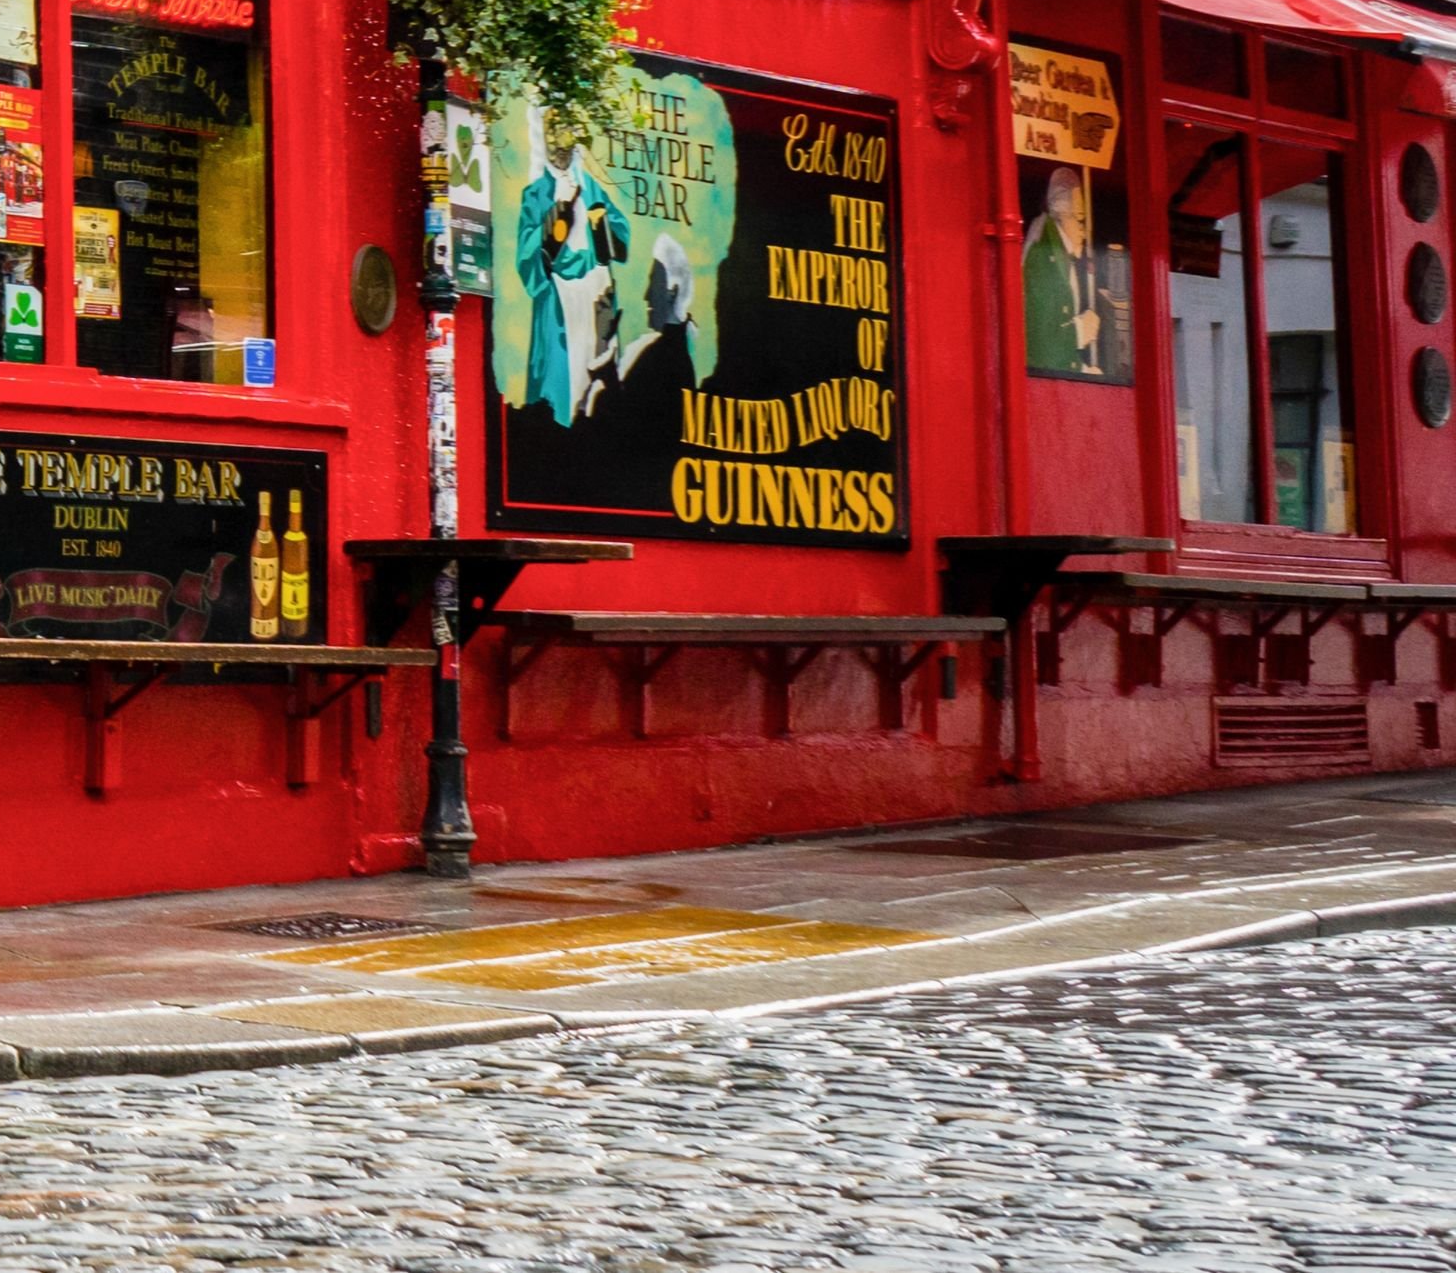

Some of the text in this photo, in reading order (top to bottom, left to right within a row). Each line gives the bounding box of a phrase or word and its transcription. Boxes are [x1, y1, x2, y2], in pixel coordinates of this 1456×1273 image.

[107, 52, 231, 119] TEMPLE BAR
[1009, 50, 1096, 98] Beer Garden
[633, 89, 687, 135] THE
[1011, 85, 1070, 130] Smoking
[603, 128, 716, 185] TEMPLE
[842, 130, 887, 185] 1840
[1025, 122, 1058, 155] Area
[632, 174, 693, 227] BAR
[830, 194, 886, 254] THE
[767, 245, 890, 315] EMPEROR
[857, 319, 889, 373] OF
[680, 375, 896, 455] MALTED LIQUORS
[17, 449, 164, 502] TEMPLE
[173, 458, 246, 507] BAR
[671, 457, 895, 534] GUINNESS
[53, 505, 129, 531] DUBLIN
[61, 538, 123, 558] EST. 1840
[16, 584, 164, 611] LIVE MUSIC DAILY
